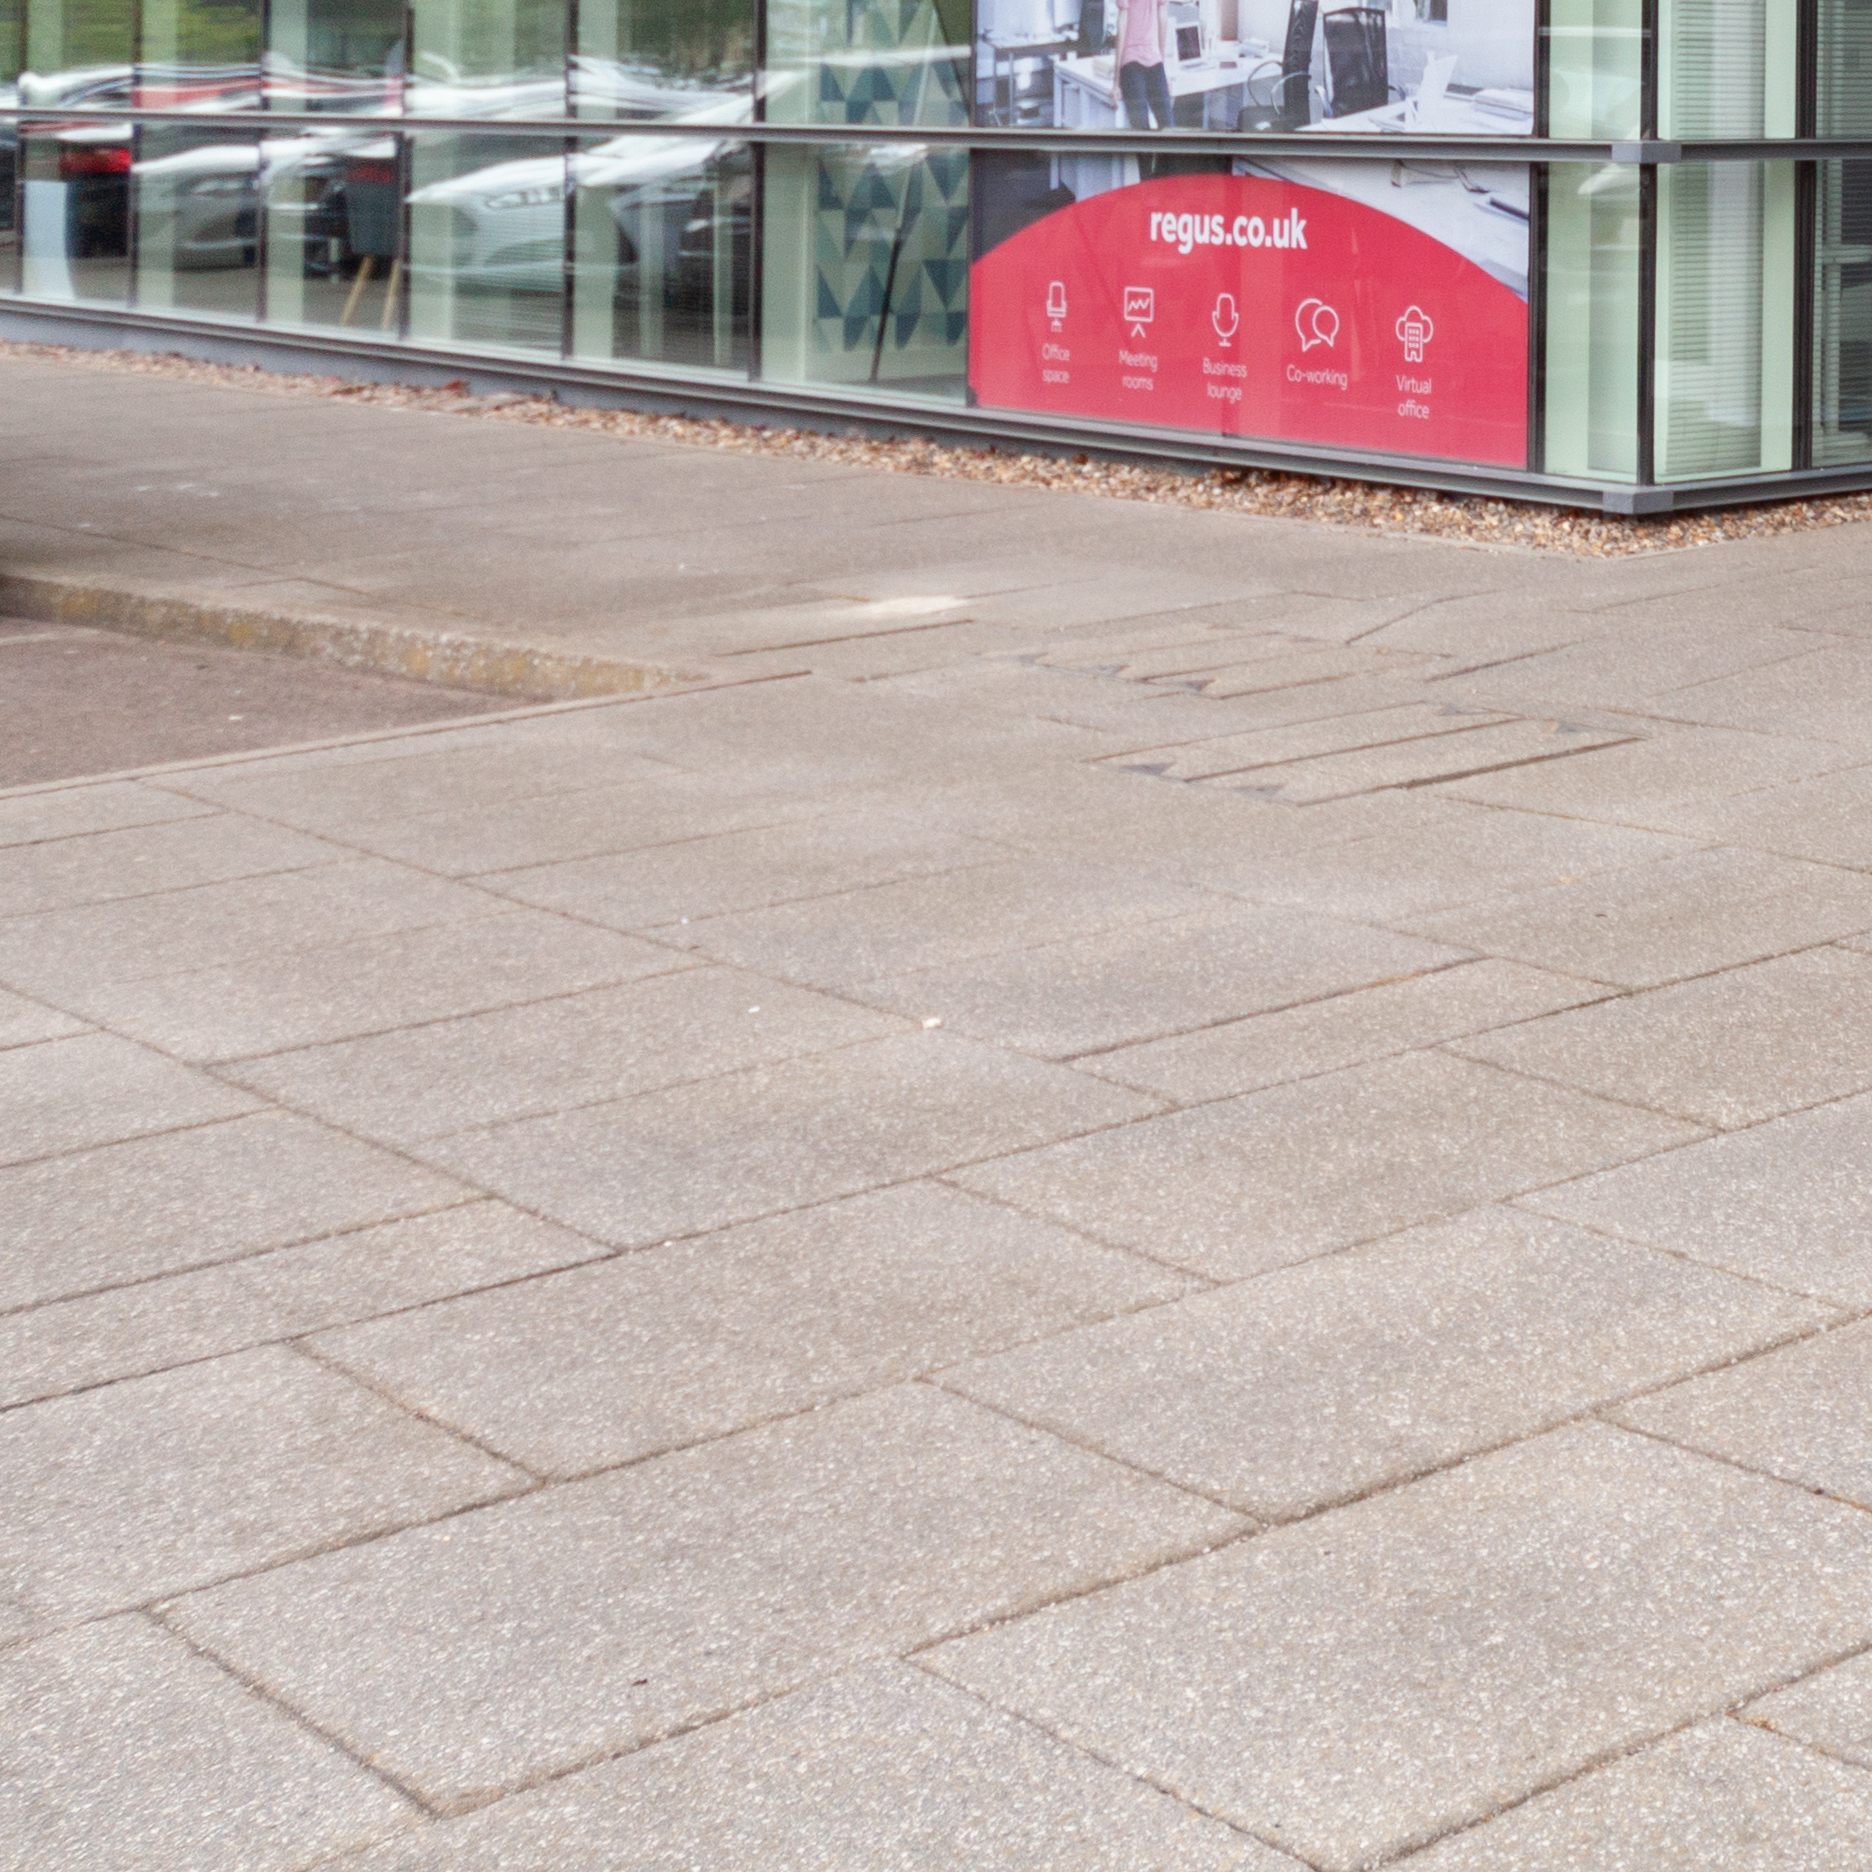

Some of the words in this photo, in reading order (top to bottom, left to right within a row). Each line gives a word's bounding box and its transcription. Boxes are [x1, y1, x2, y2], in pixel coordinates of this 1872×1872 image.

[1149, 207, 1308, 255] regus.co.uk
[1042, 343, 1070, 361] Office
[1119, 349, 1158, 373] Meeting
[1042, 369, 1070, 385] space
[1202, 356, 1248, 378] Business
[1286, 364, 1348, 391] Co-working
[1122, 375, 1154, 391] rooms
[1207, 382, 1242, 404] lounge
[1396, 375, 1433, 394] Virtual
[1397, 399, 1430, 419] office
